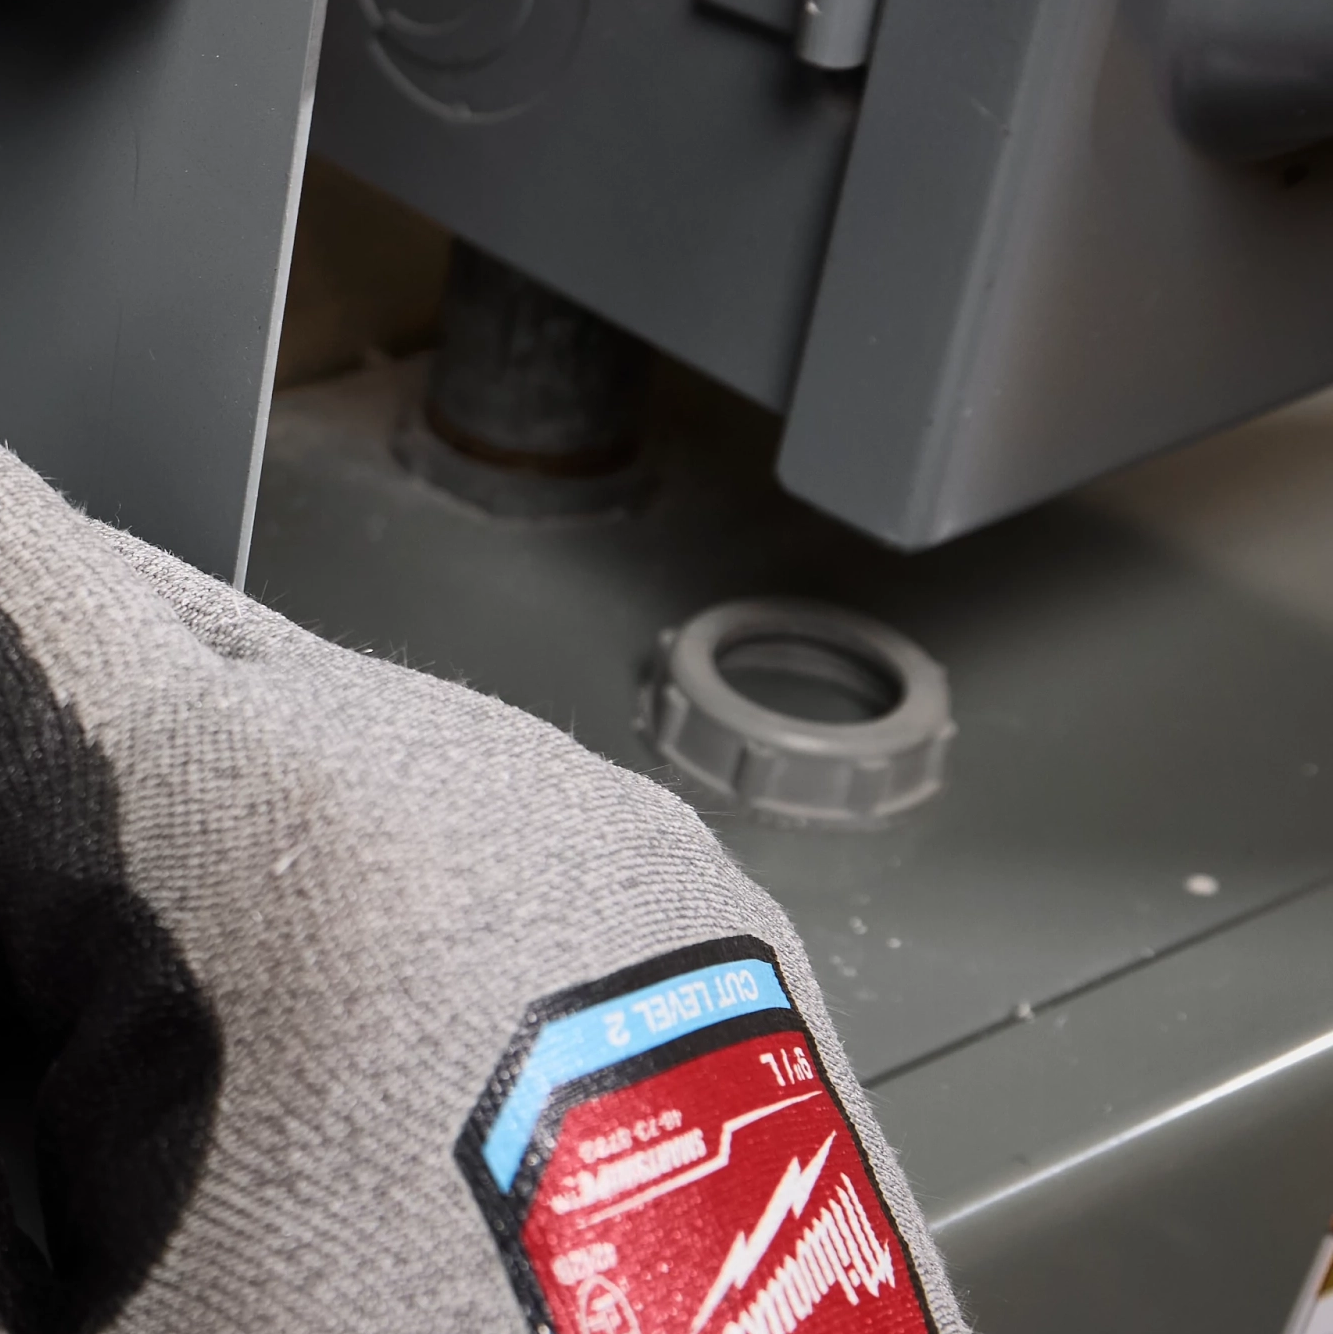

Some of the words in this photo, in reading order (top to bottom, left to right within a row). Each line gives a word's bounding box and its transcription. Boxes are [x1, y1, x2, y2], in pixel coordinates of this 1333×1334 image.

[633, 980, 715, 1035] LEVEL
[717, 969, 760, 1008] CUT
[602, 1010, 631, 1047] 2
